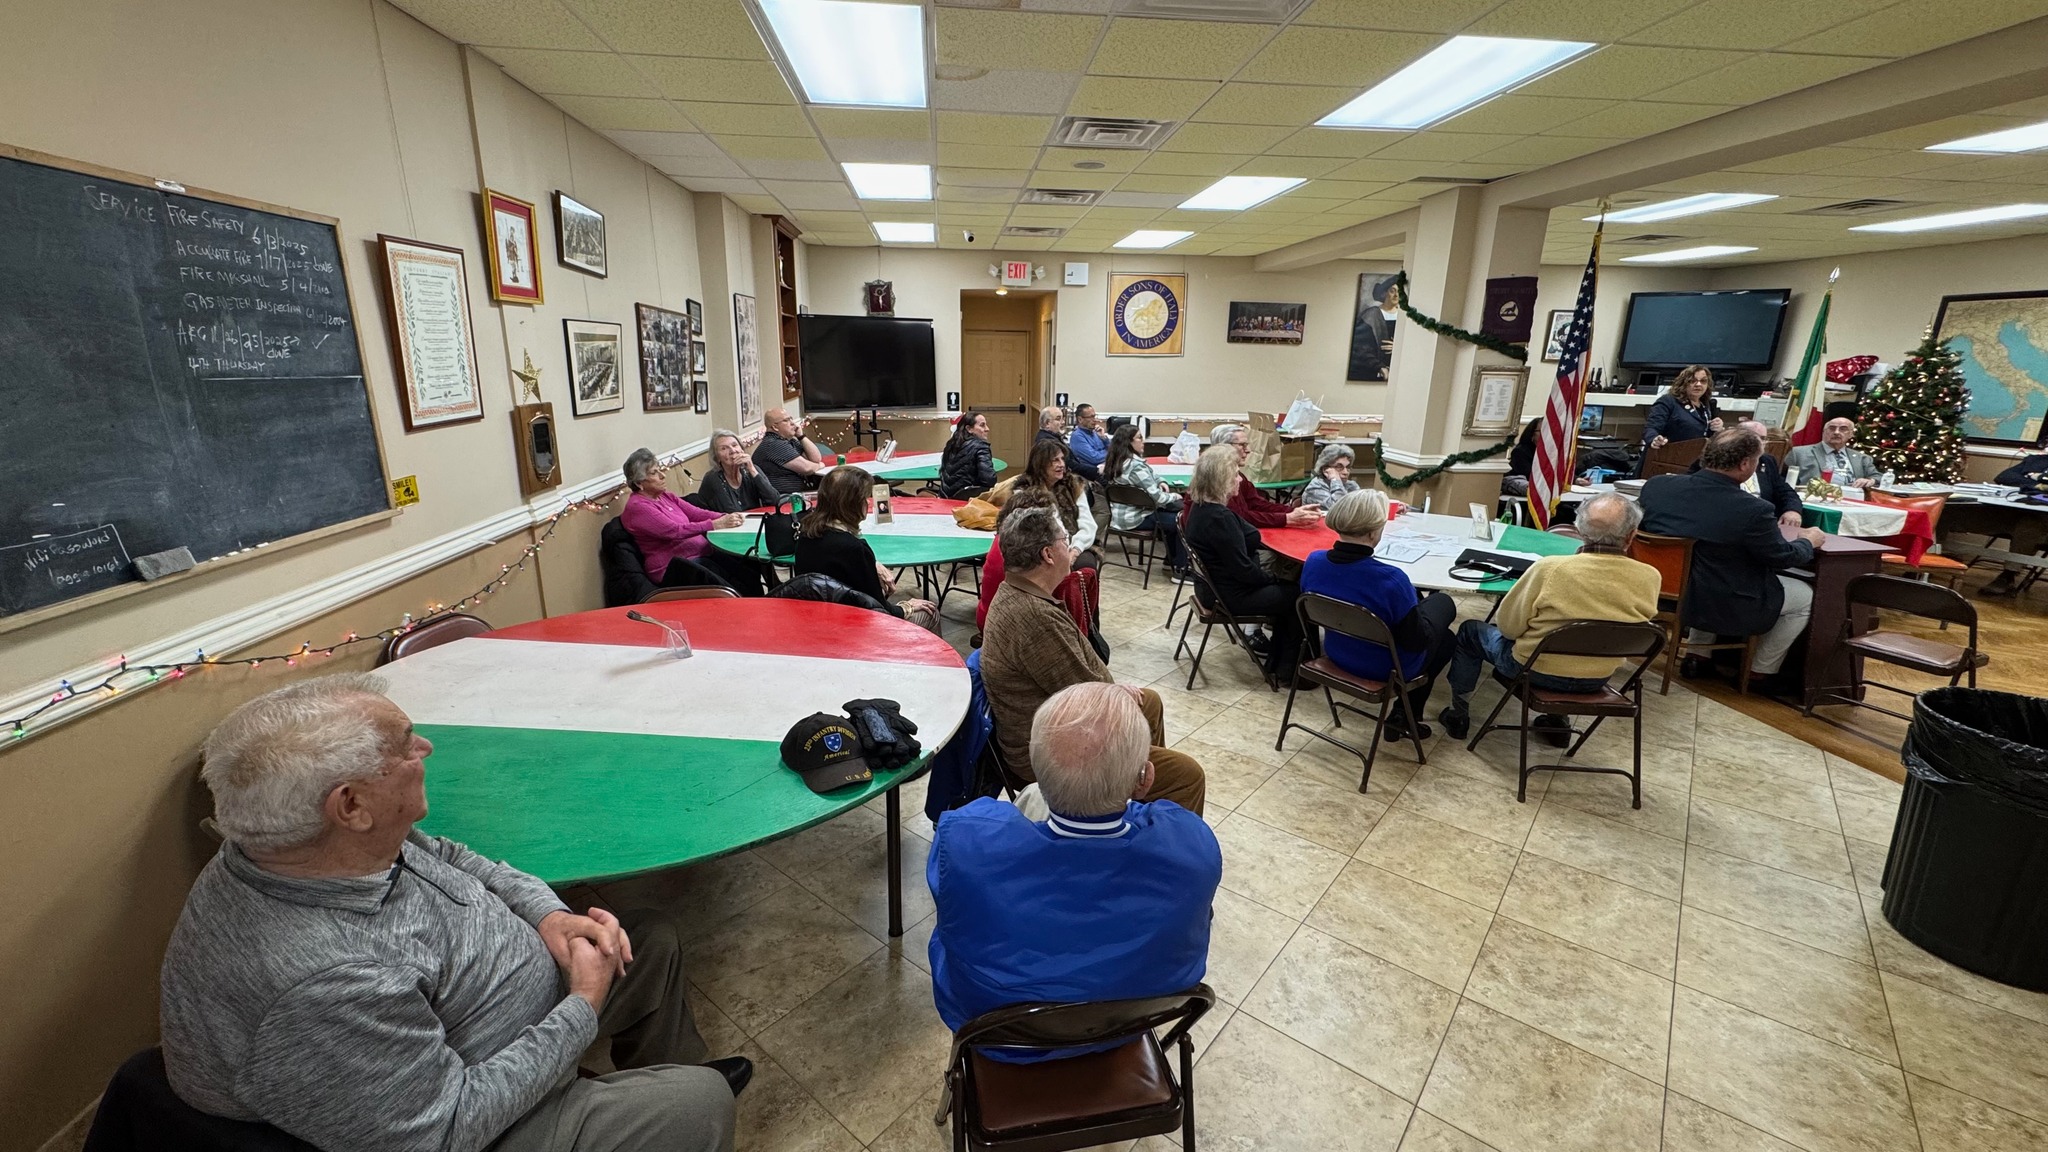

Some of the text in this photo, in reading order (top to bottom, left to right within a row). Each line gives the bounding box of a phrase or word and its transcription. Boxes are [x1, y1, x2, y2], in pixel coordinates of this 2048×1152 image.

[166, 202, 198, 227] FIRE
[201, 210, 244, 235] SAFETY
[180, 266, 214, 283] FIRE
[1007, 262, 1027, 279] EXIT
[183, 292, 215, 312] GAS
[1115, 281, 1178, 327] ORDER SONS OF ITALY
[1121, 327, 1173, 348] IN AMERICA
[214, 358, 266, 373] THURSDAY
